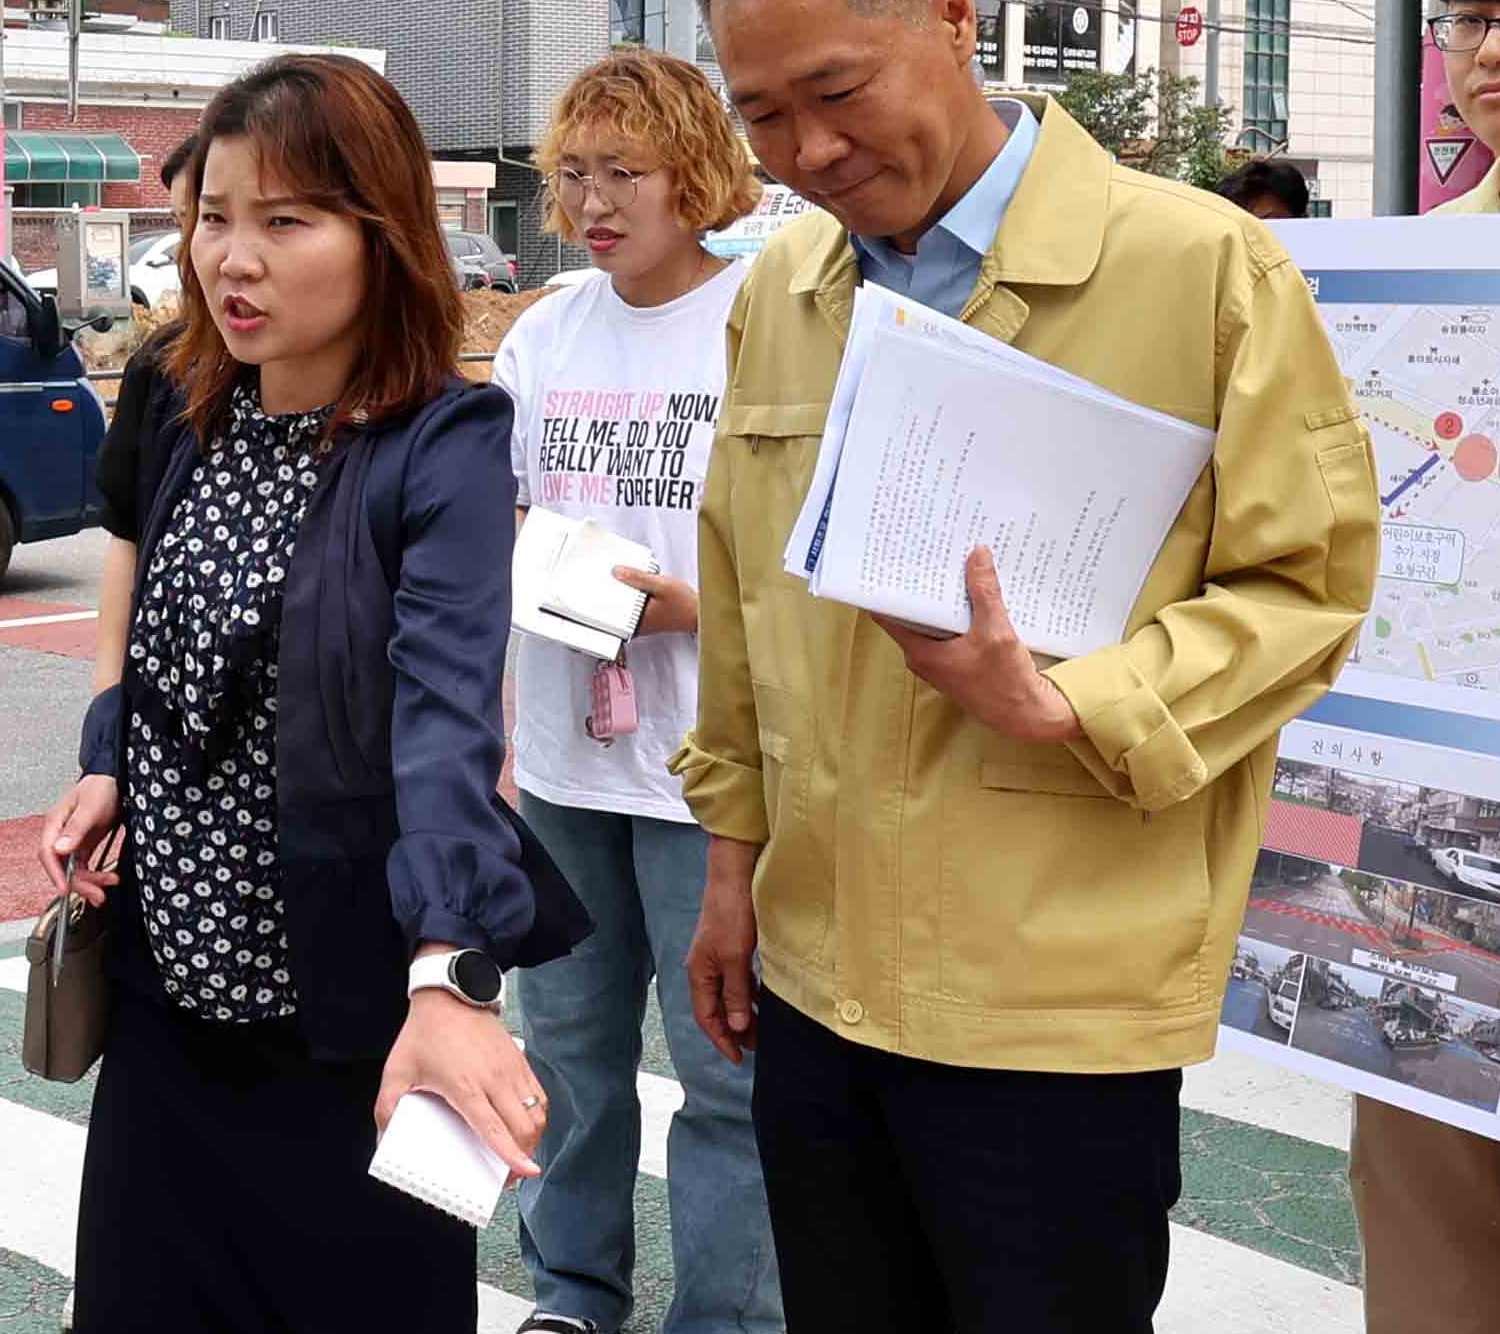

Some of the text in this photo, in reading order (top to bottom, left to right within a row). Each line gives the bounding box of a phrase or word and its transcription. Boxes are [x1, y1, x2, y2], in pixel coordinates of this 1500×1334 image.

[1177, 28, 1198, 43] STOP
[544, 390, 634, 418] STRAIGHT
[637, 393, 665, 423] UP
[542, 418, 579, 444] TELL
[626, 421, 650, 448] DO
[654, 421, 693, 449] YOU
[539, 444, 685, 478] REALLY WANT TO
[578, 475, 613, 505] ME
